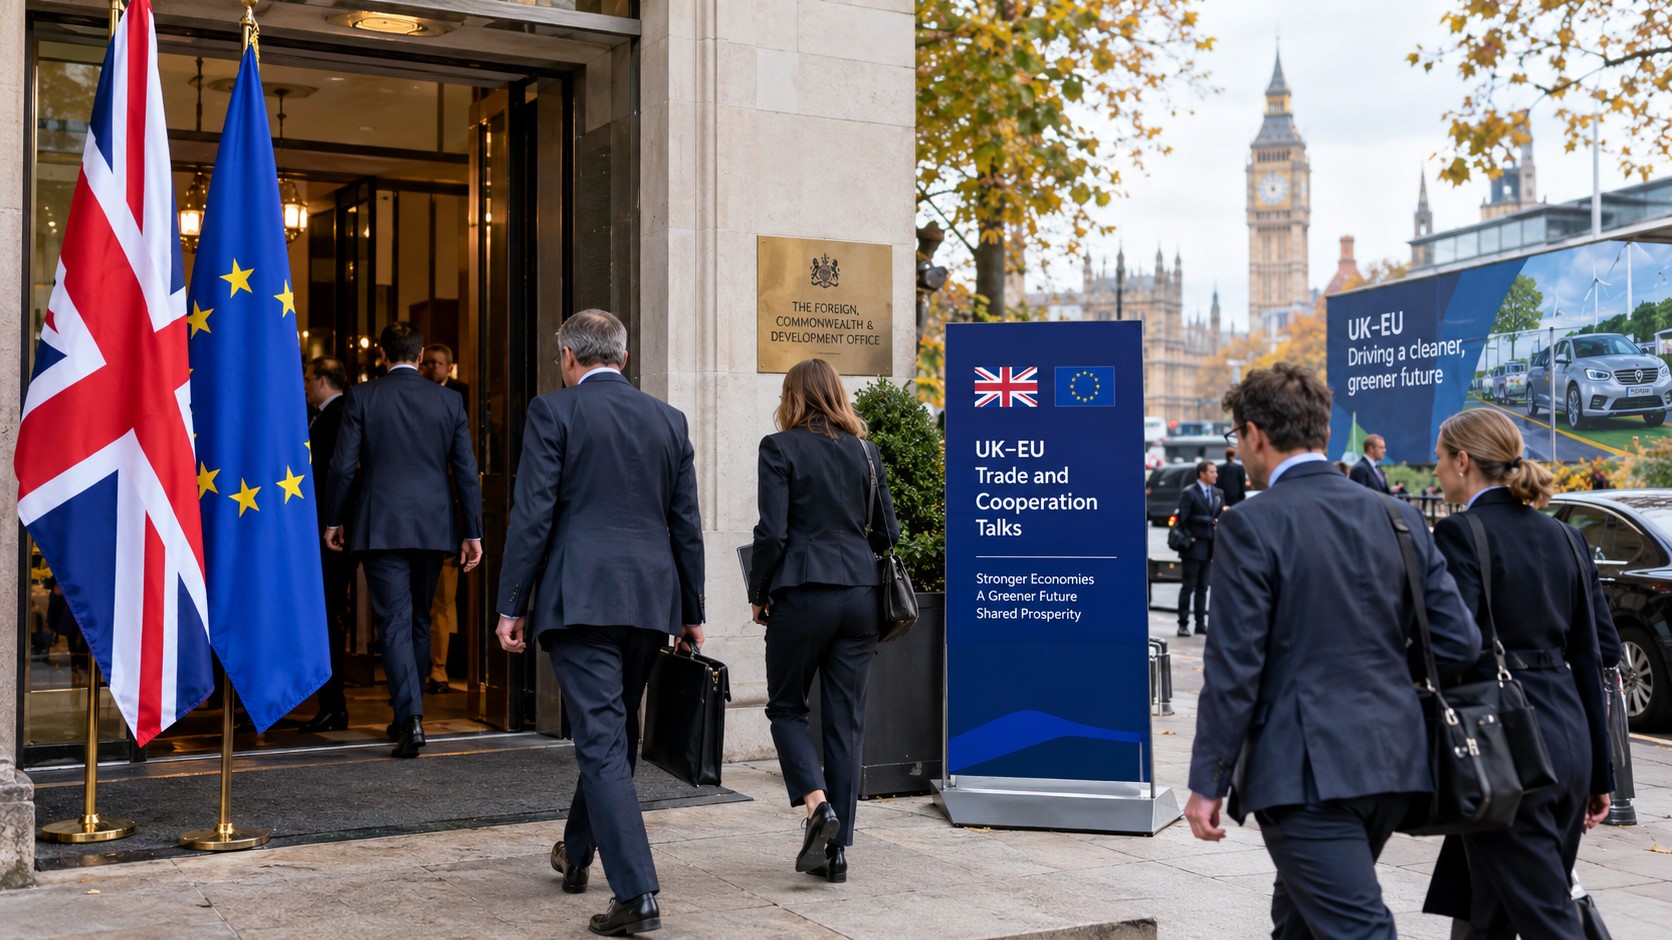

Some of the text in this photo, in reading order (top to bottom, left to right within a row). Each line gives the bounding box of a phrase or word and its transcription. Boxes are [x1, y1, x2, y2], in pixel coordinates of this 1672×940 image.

[792, 301, 859, 316] THE FOREIGN,
[776, 316, 874, 330] COMMONWEALTH &
[771, 331, 880, 345] DEVELOPMENT OFFICE
[1348, 338, 1465, 367] Driving a cleaner,
[1348, 366, 1443, 397] greener future
[975, 466, 1069, 484] Trade and
[976, 492, 1098, 514] Cooperation
[976, 518, 1022, 537] Talks
[976, 573, 1095, 587] Stronger Economies
[976, 590, 1077, 602] A Greener Future
[976, 608, 1081, 622] Shared Prosperity
